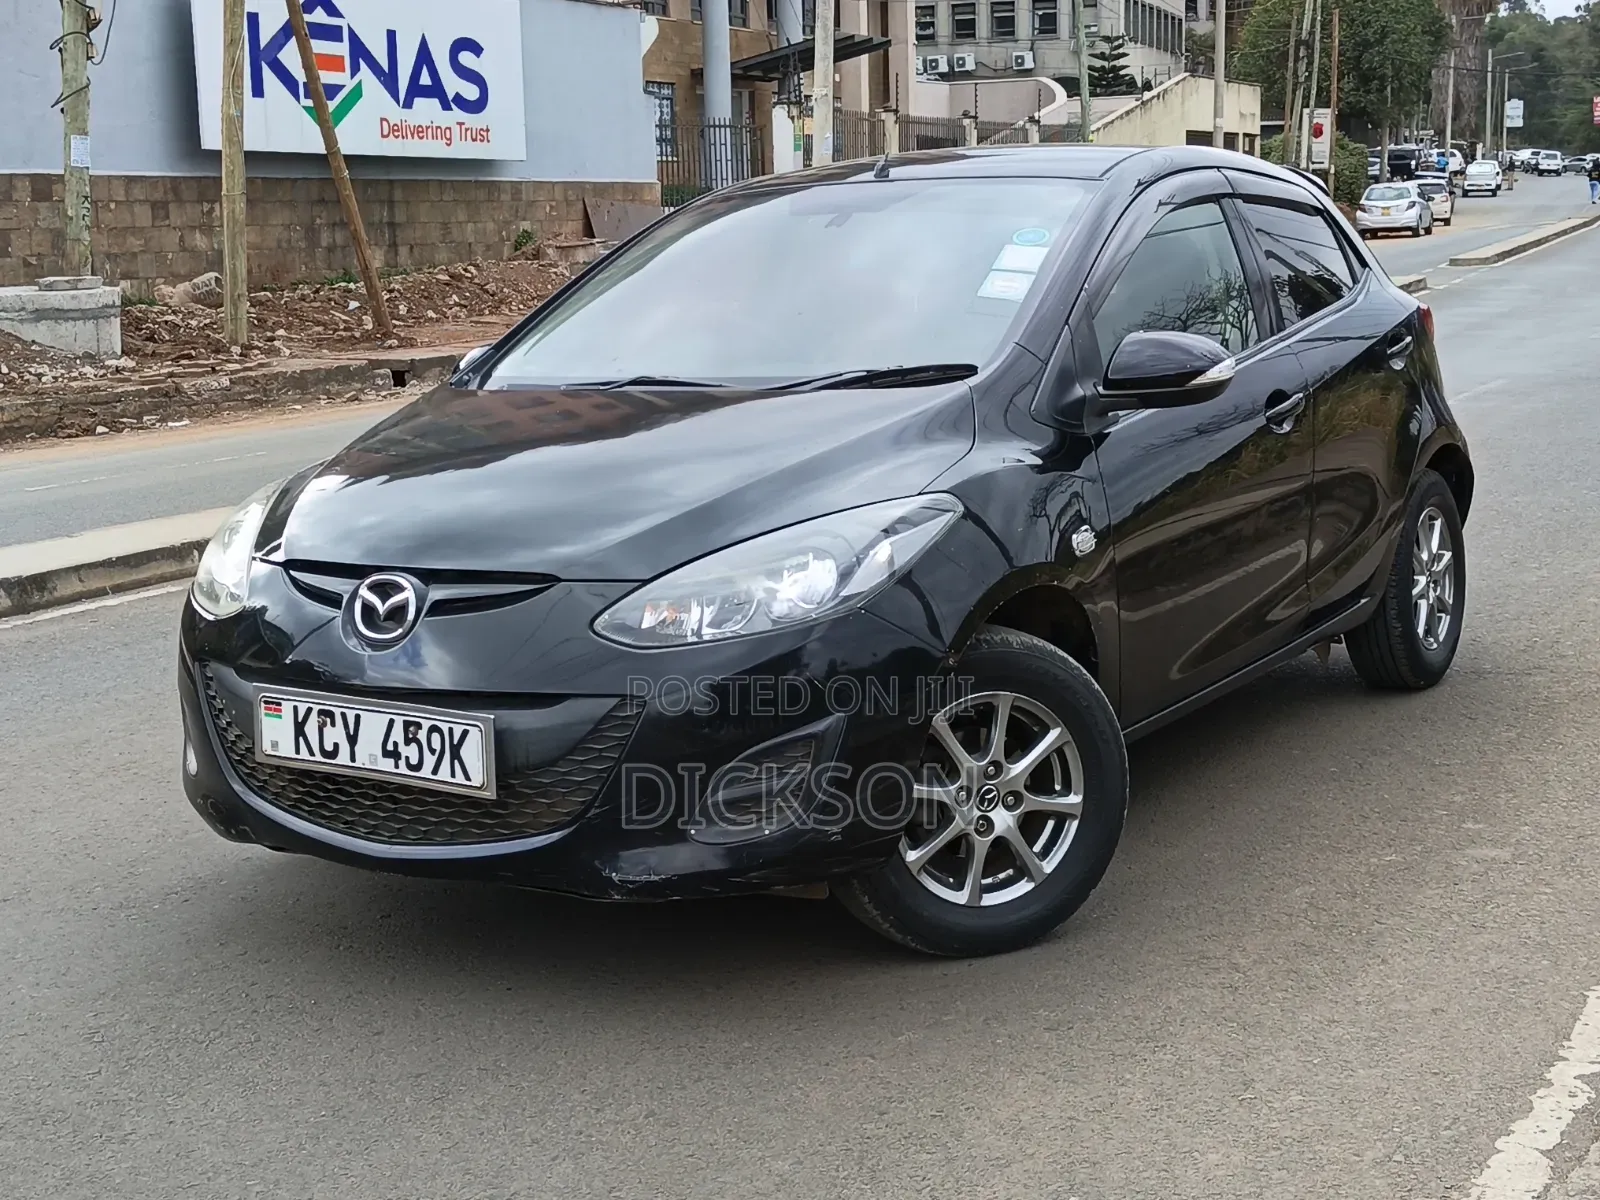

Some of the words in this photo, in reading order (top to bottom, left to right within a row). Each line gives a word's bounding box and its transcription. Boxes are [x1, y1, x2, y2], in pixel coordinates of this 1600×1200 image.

[246, 1, 489, 116] KENAS
[379, 116, 453, 147] Delivering
[456, 120, 491, 144] Trust
[292, 704, 361, 764] KCY
[380, 717, 473, 783] 459K
